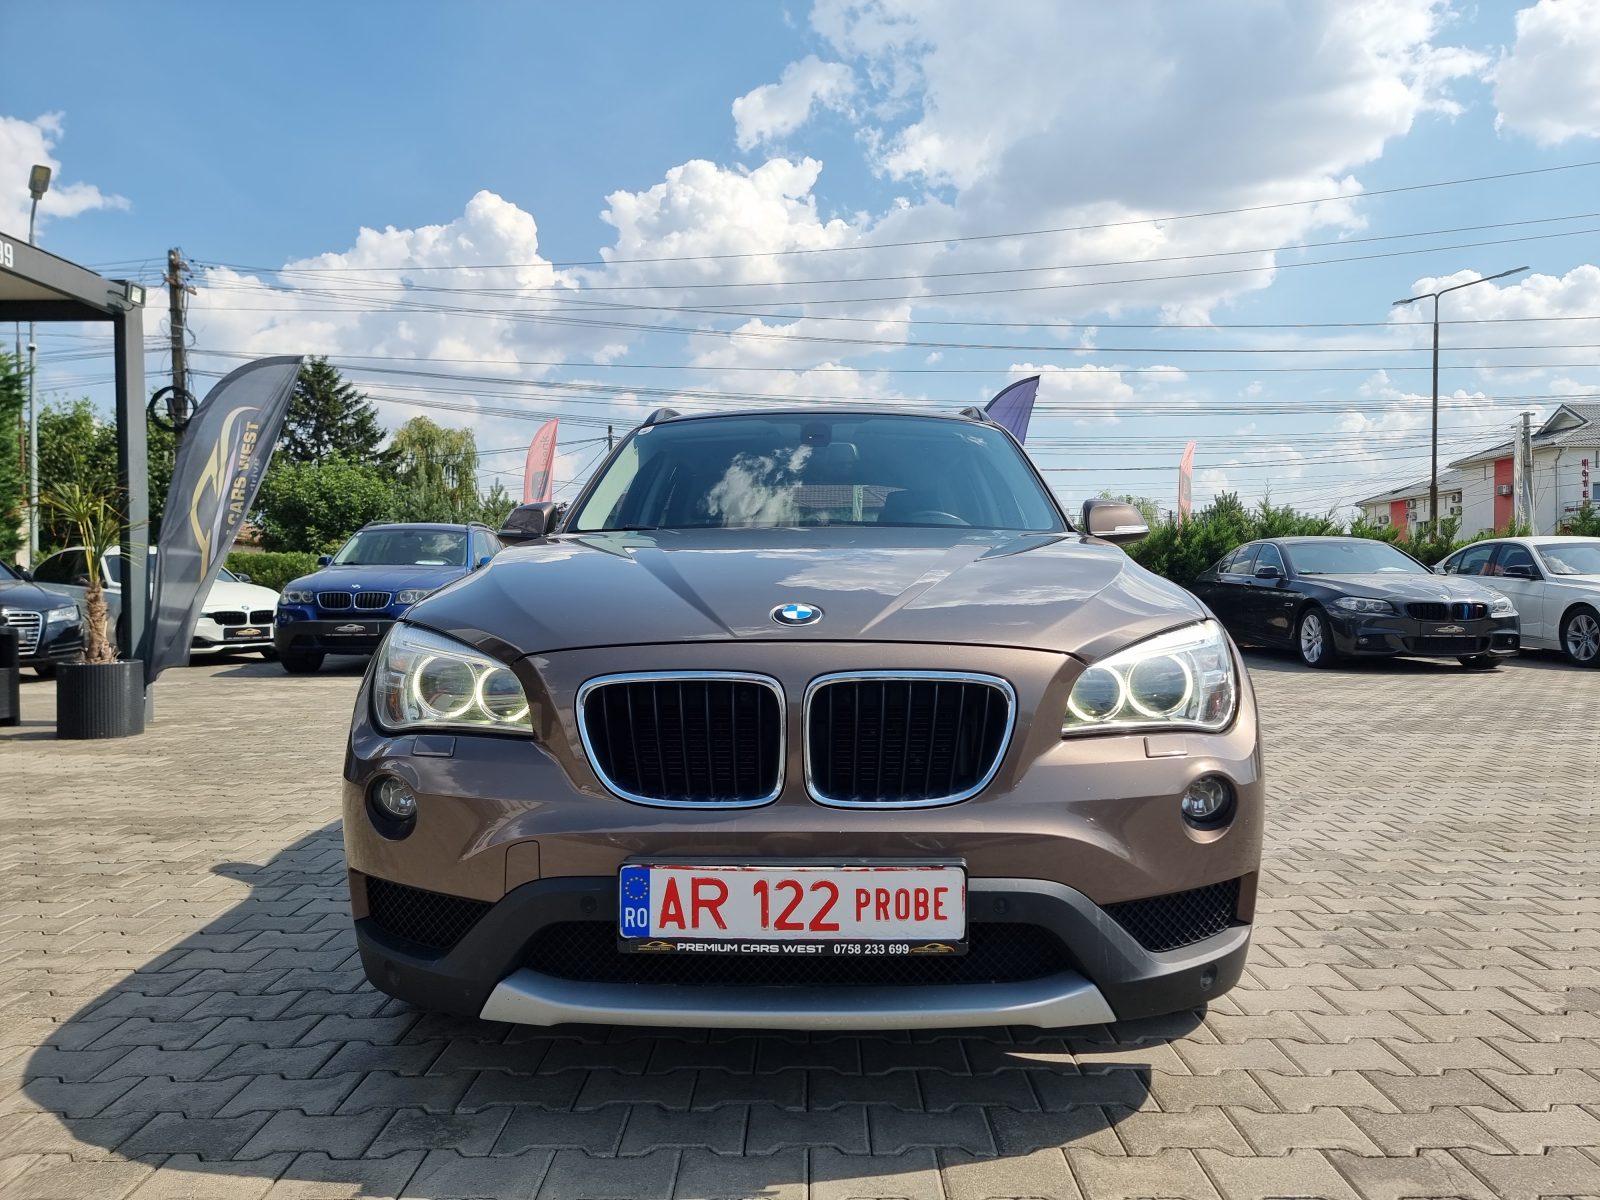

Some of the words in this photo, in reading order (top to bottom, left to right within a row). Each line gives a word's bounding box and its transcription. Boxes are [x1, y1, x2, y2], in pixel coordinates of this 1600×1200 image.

[227, 476, 247, 525] CARS
[238, 421, 259, 471] WEST
[625, 907, 648, 928] RO
[659, 877, 729, 930] AR
[753, 879, 840, 931] 122
[855, 887, 949, 922] PROBE
[677, 942, 738, 953] PREMIUM
[740, 943, 780, 954] CARS
[782, 944, 825, 954] WEST
[833, 943, 861, 955] 0758
[864, 943, 886, 955] 233
[888, 943, 910, 955] 699
